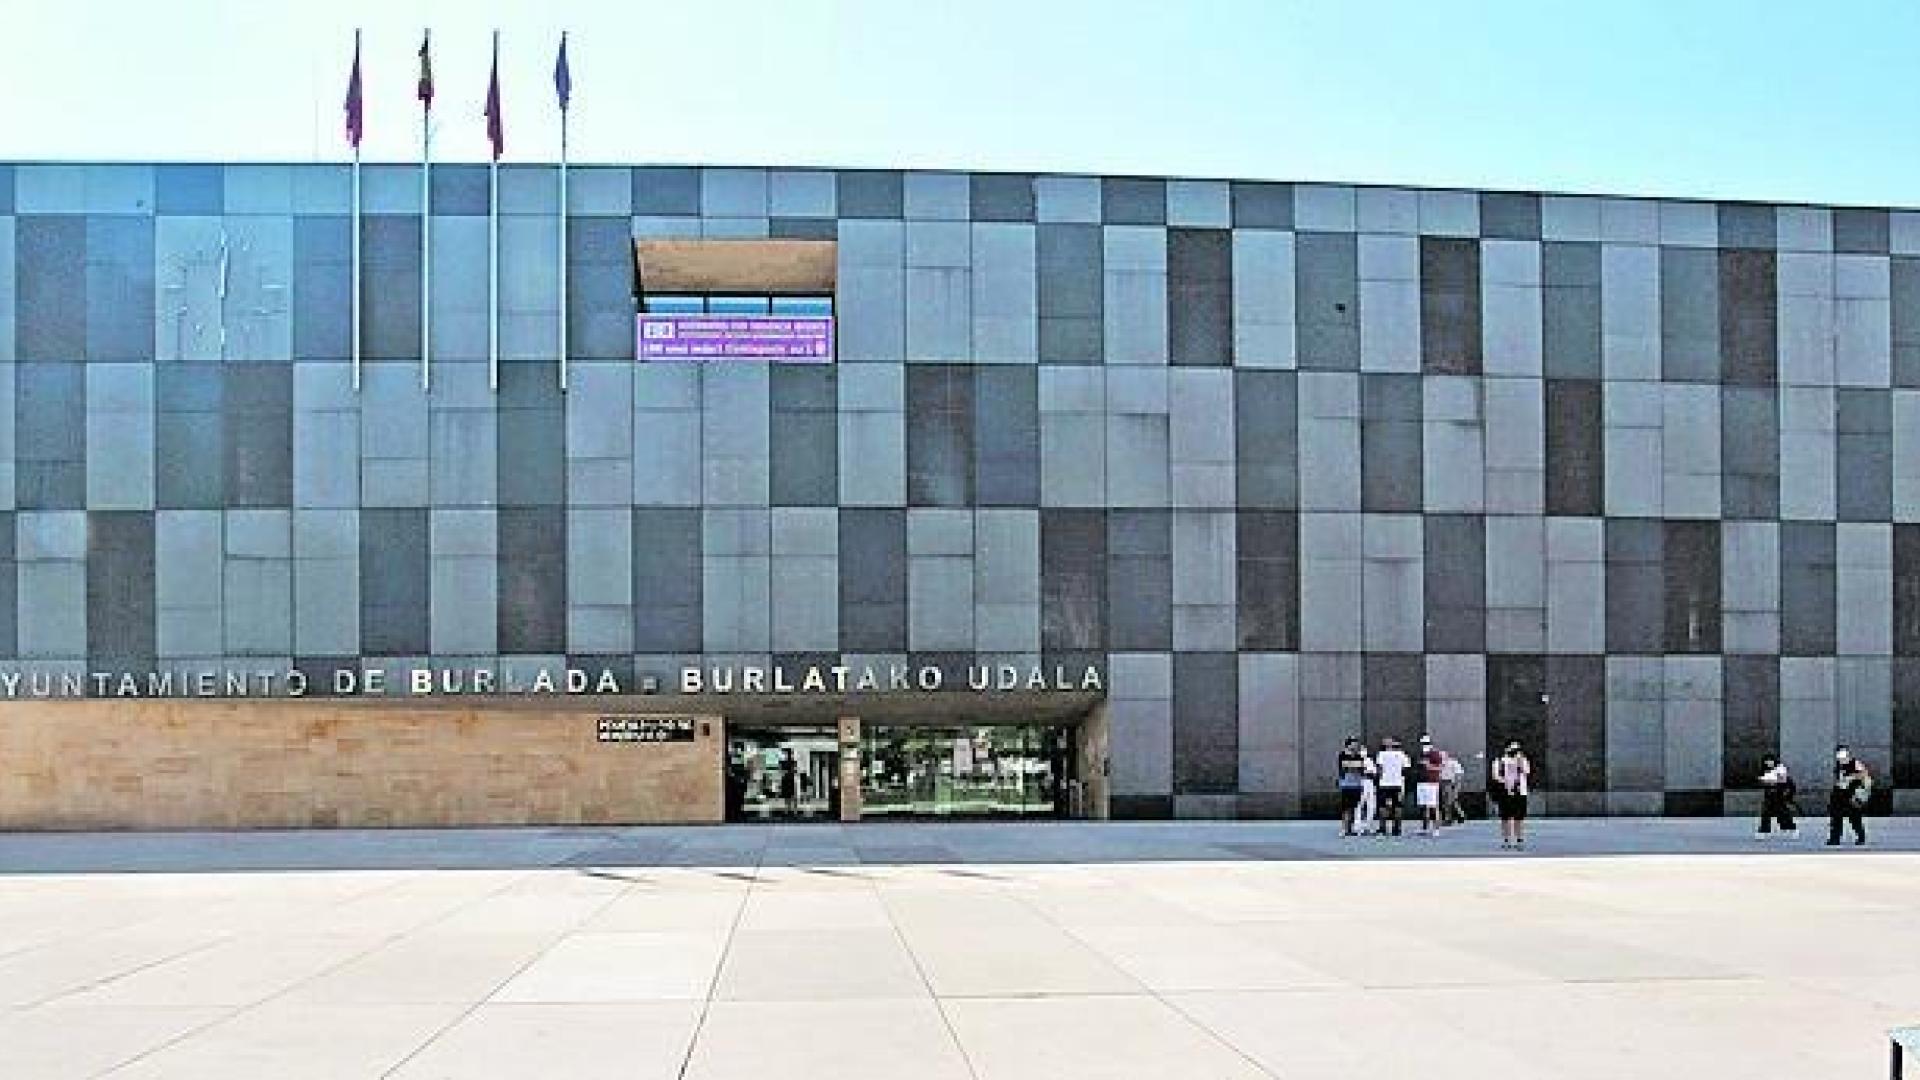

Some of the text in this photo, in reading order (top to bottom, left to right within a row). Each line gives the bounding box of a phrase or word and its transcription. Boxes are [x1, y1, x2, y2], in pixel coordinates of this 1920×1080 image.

[1, 664, 1103, 697] YUNTAMIENTO DE BURLADA BURLATAKO UDALA
